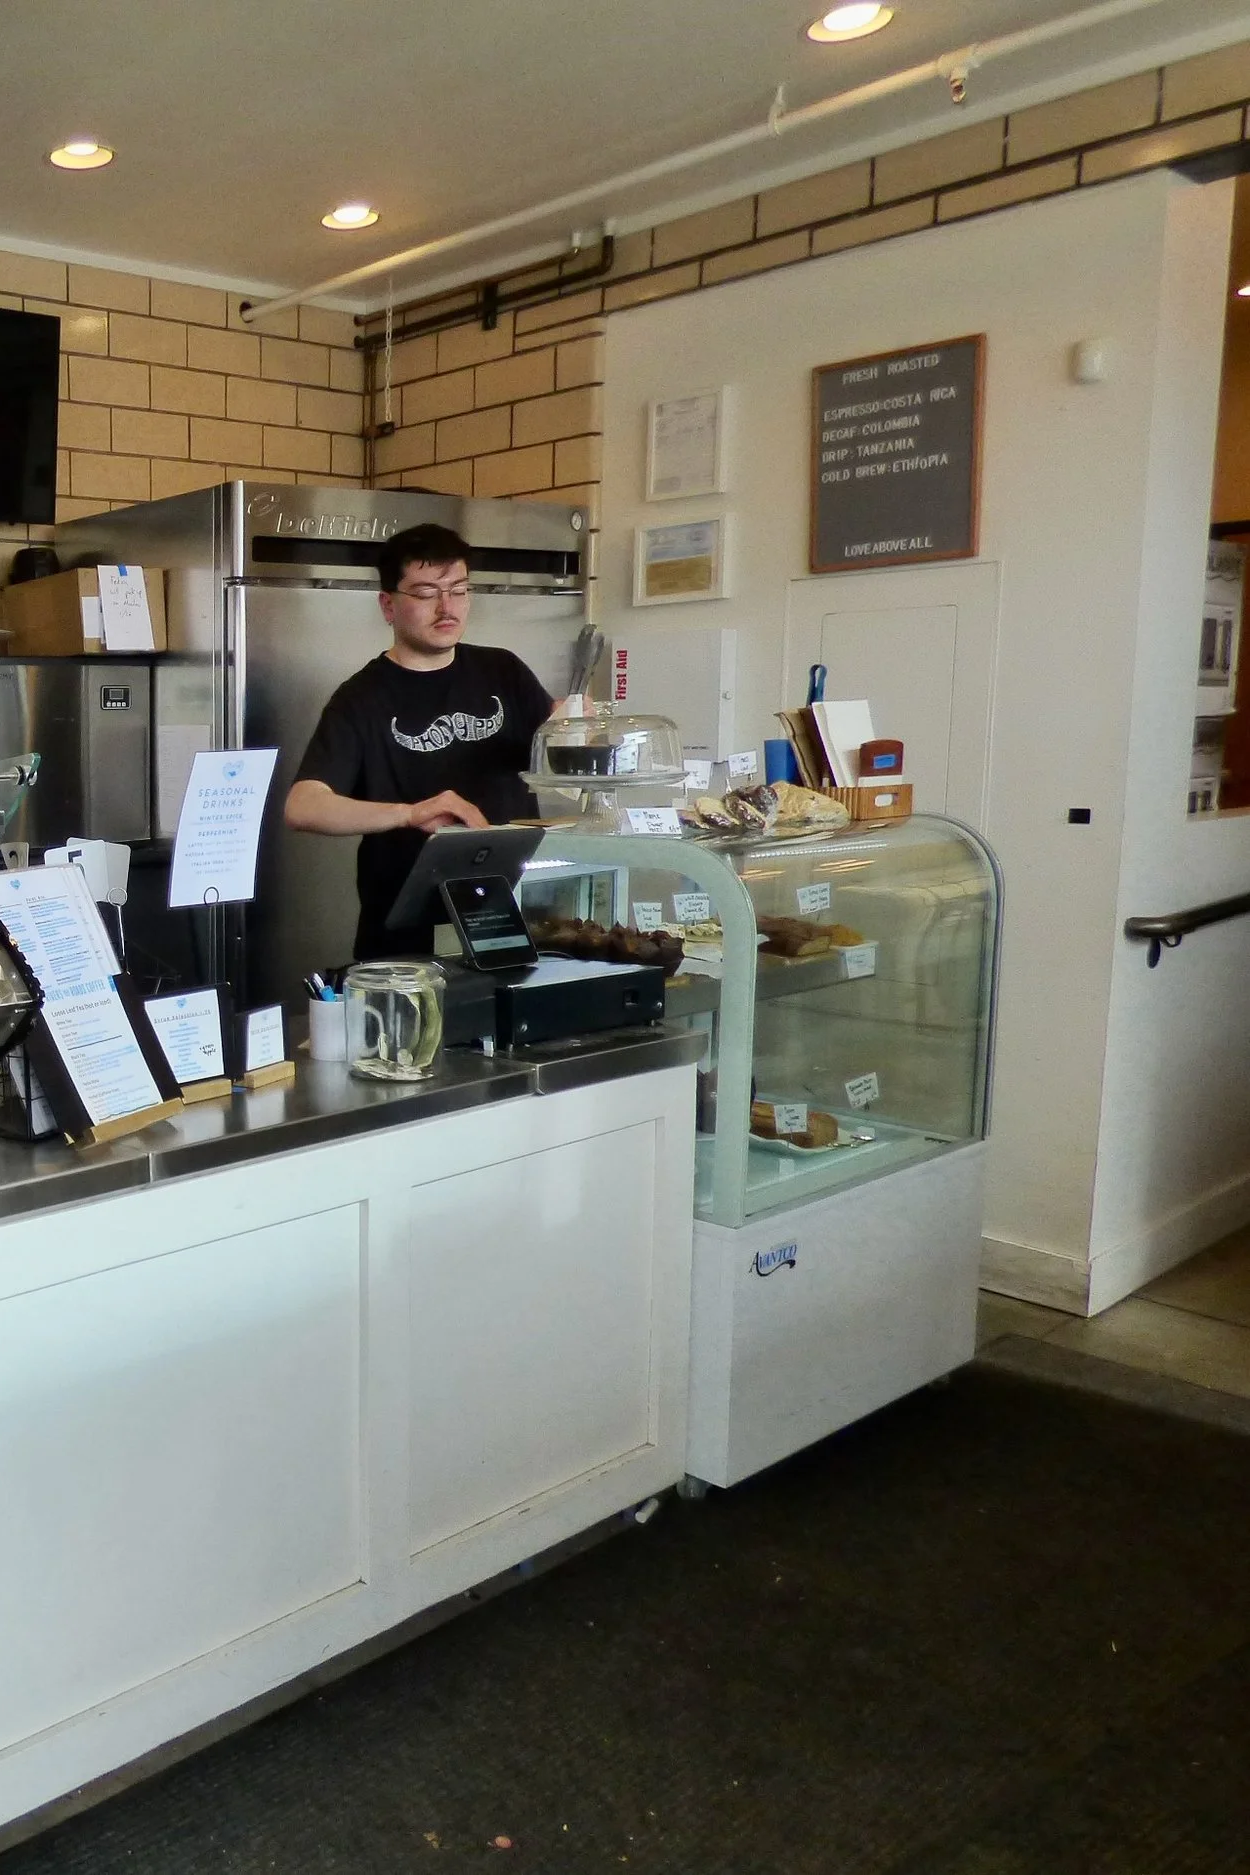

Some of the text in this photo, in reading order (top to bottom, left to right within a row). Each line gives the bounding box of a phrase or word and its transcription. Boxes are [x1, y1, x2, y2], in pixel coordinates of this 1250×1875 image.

[842, 353, 940, 385] FRESH ROASTED
[930, 386, 956, 402] RICA
[857, 438, 915, 457] TANZANIA
[821, 469, 850, 483] COLD
[844, 536, 933, 557] LOVE ABOVE ALL
[615, 650, 627, 700] First Aid
[198, 788, 255, 798] SEASONAL
[202, 798, 244, 809] DRINKS
